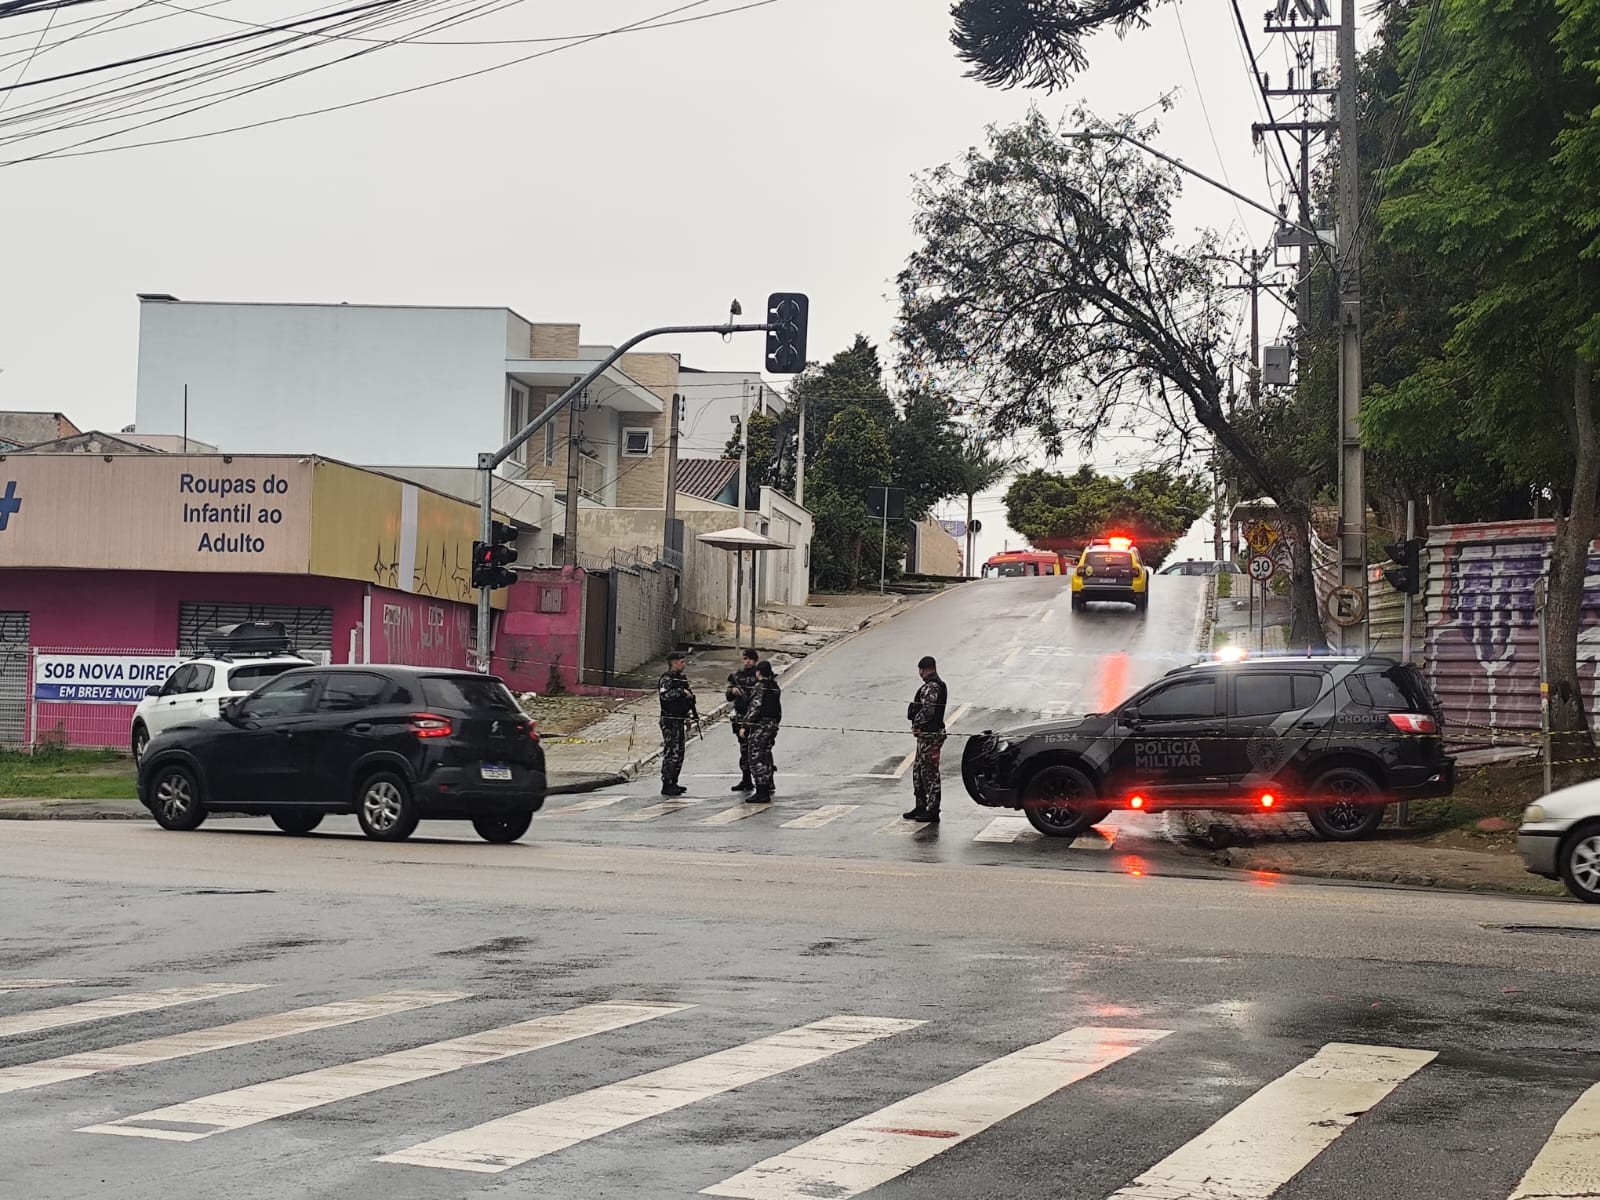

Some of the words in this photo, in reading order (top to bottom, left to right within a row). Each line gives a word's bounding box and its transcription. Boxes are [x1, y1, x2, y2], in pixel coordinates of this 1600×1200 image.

[180, 473, 256, 498] Roupas
[263, 474, 288, 494] do
[183, 503, 251, 523] Infantil
[257, 508, 282, 523] ao
[197, 532, 265, 552] Adulto
[1252, 560, 1270, 572] 30
[44, 663, 75, 679] SOB
[79, 663, 125, 680] NOVA
[59, 686, 75, 698] EM
[78, 687, 113, 699] BREVE
[1337, 714, 1385, 724] CHOQUE
[1135, 754, 1201, 767] MILITAR
